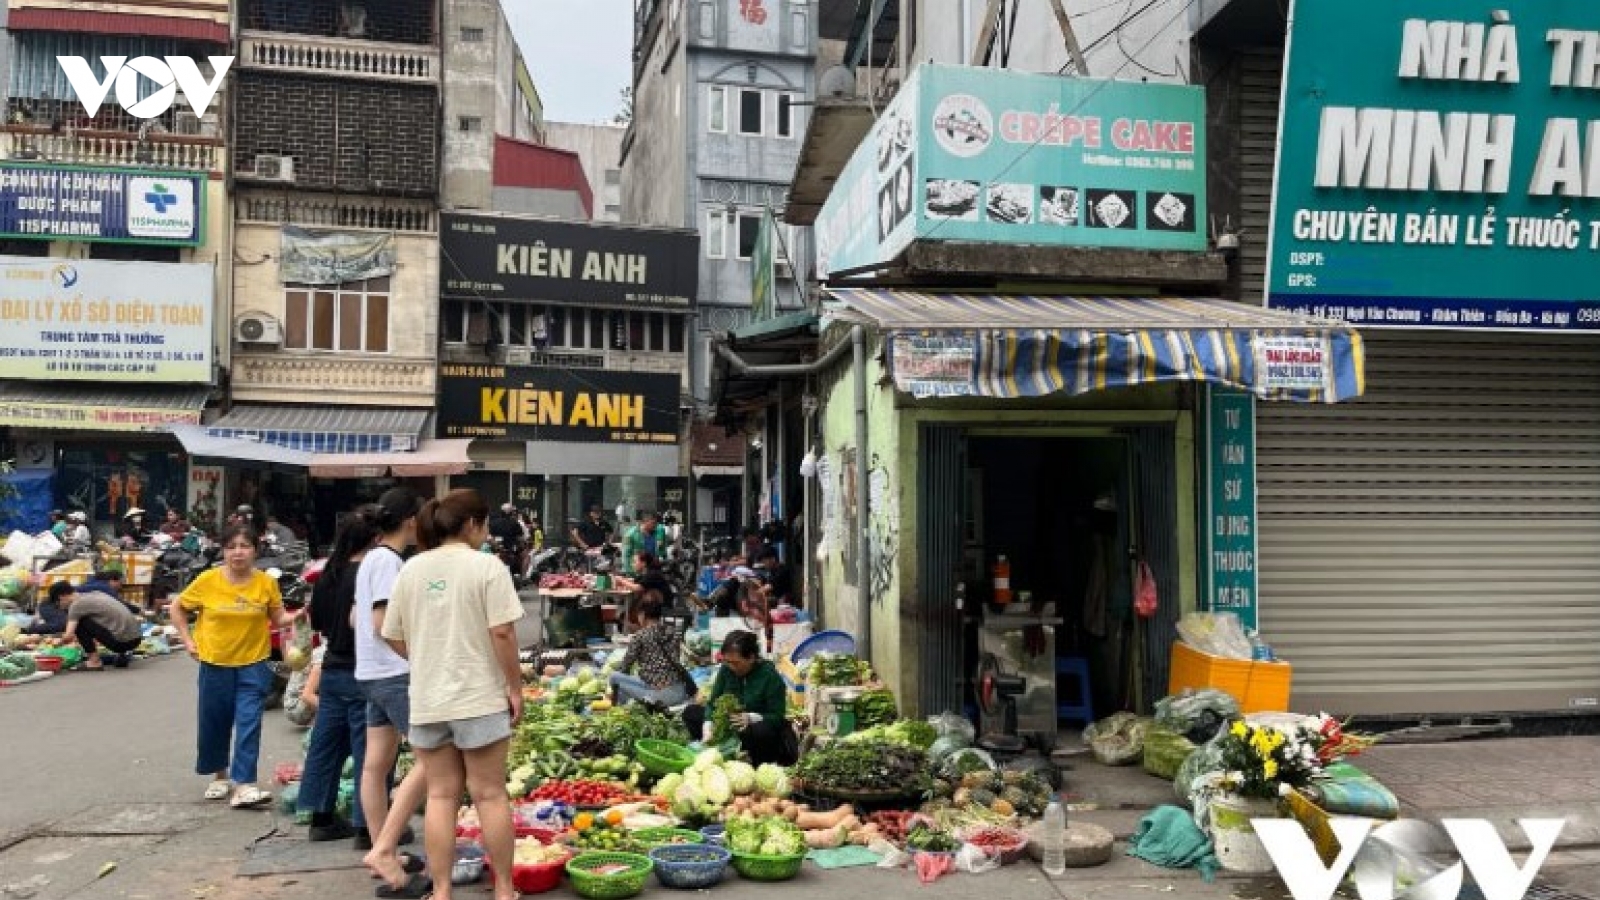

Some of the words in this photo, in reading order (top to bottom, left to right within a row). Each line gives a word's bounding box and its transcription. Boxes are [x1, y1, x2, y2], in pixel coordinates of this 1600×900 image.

[1399, 10, 1520, 83] NHÀ
[1111, 118, 1194, 153] CAKE
[1314, 106, 1515, 193] MINH
[19, 219, 100, 235] 115PHARMA
[1293, 206, 1397, 243] CHUYÊN
[1403, 210, 1458, 245] BÁN
[1465, 207, 1496, 246] LẺ
[1506, 208, 1580, 249] THUỐC
[496, 240, 572, 278] KIÊN
[582, 251, 647, 284] ANH
[480, 382, 563, 425] KIÊN
[569, 393, 644, 428] ANH
